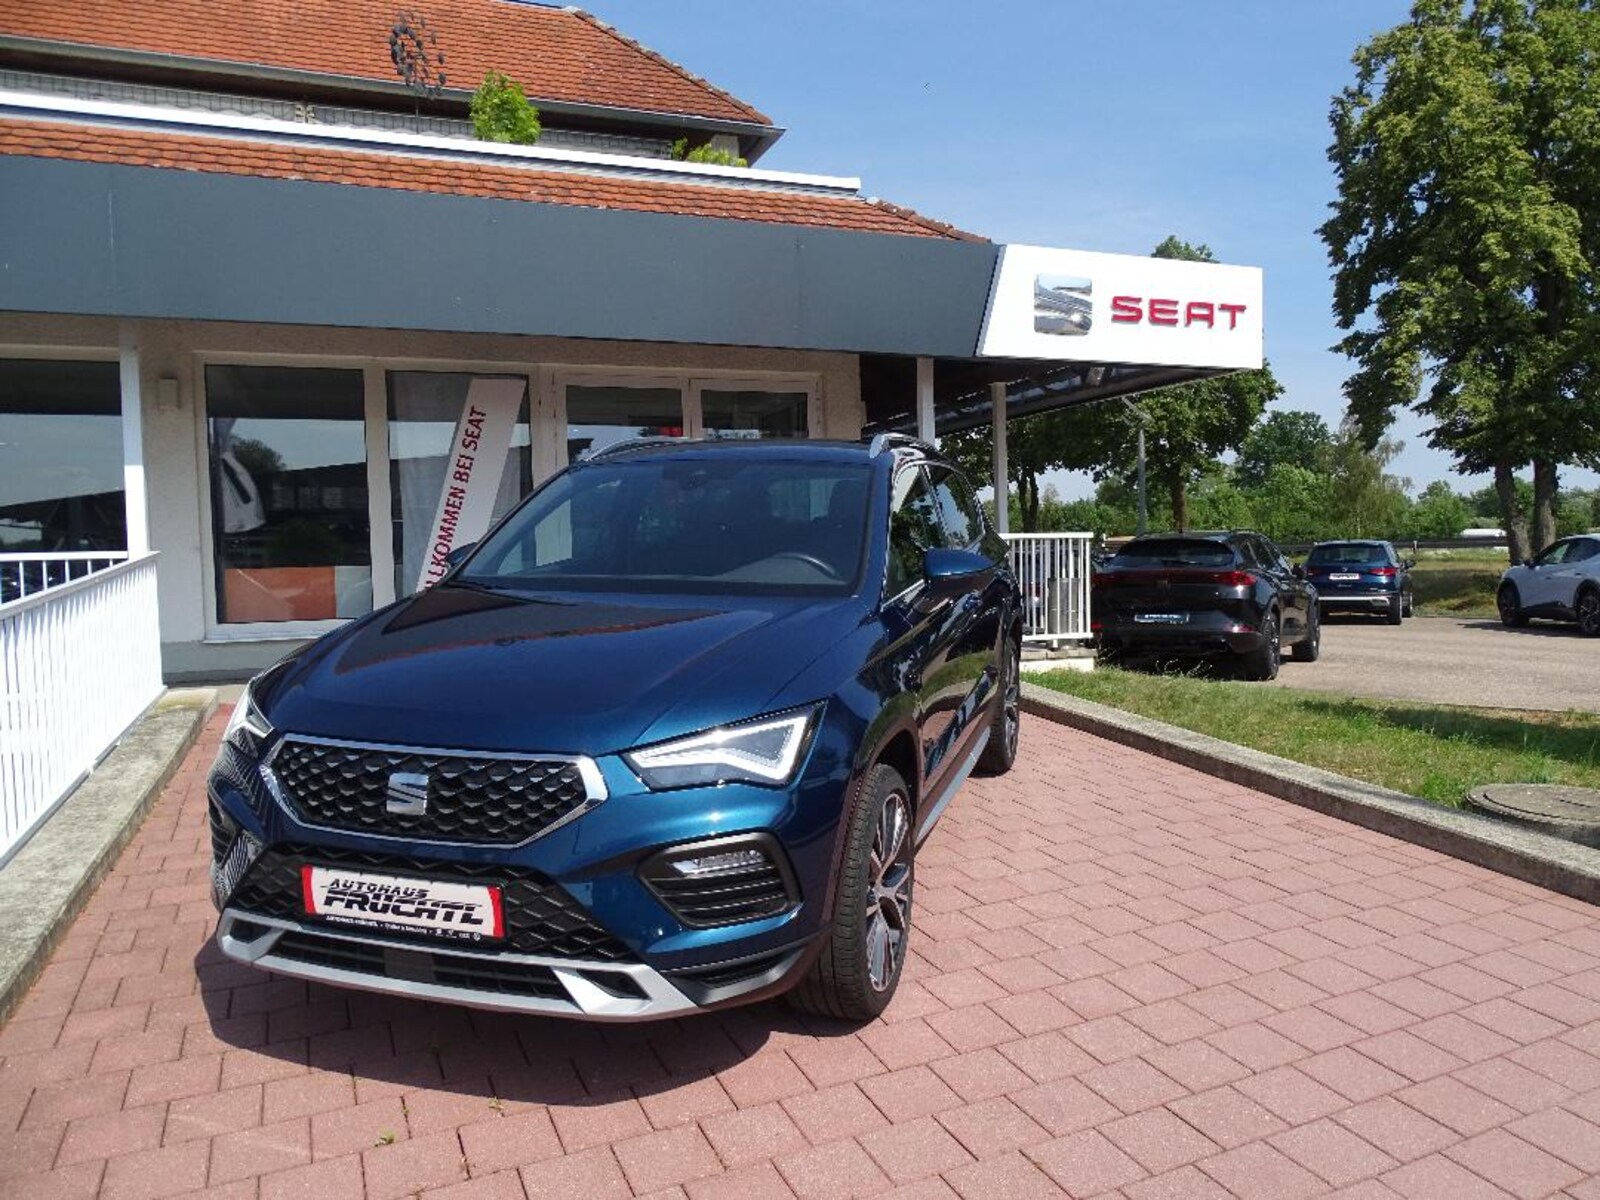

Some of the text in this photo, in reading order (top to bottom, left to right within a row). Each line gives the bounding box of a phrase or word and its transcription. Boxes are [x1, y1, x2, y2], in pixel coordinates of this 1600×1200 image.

[1111, 296, 1246, 330] SEAT
[462, 405, 487, 452] SEAT
[453, 453, 475, 483] BEI
[330, 878, 430, 899] AUTOHAUS
